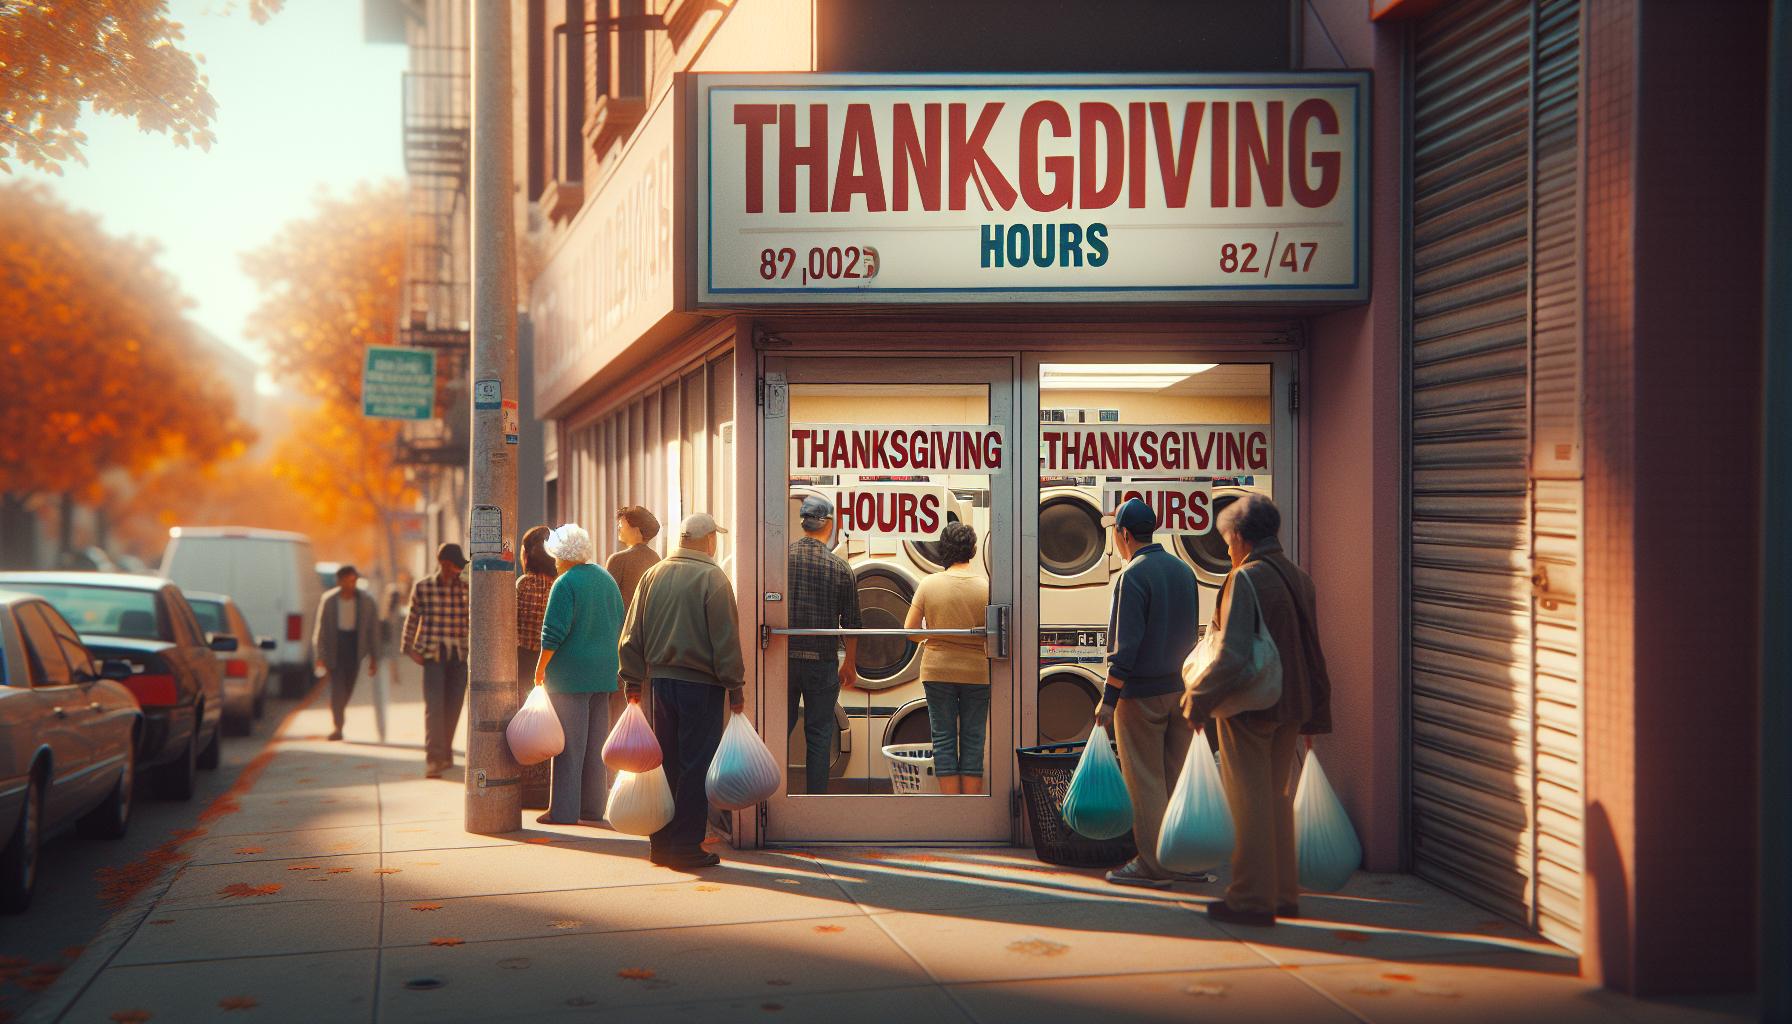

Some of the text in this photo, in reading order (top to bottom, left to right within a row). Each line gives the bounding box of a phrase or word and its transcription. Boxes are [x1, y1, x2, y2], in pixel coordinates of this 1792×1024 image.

[733, 98, 1342, 213] THANKGDIVING
[980, 223, 1109, 268] HOURS
[1219, 231, 1319, 279] 82/47
[791, 429, 1003, 470] THANKSGIVING
[1043, 430, 1268, 470] THANKSGIVING
[836, 491, 940, 534] HOURS
[1114, 490, 1210, 531] URS
